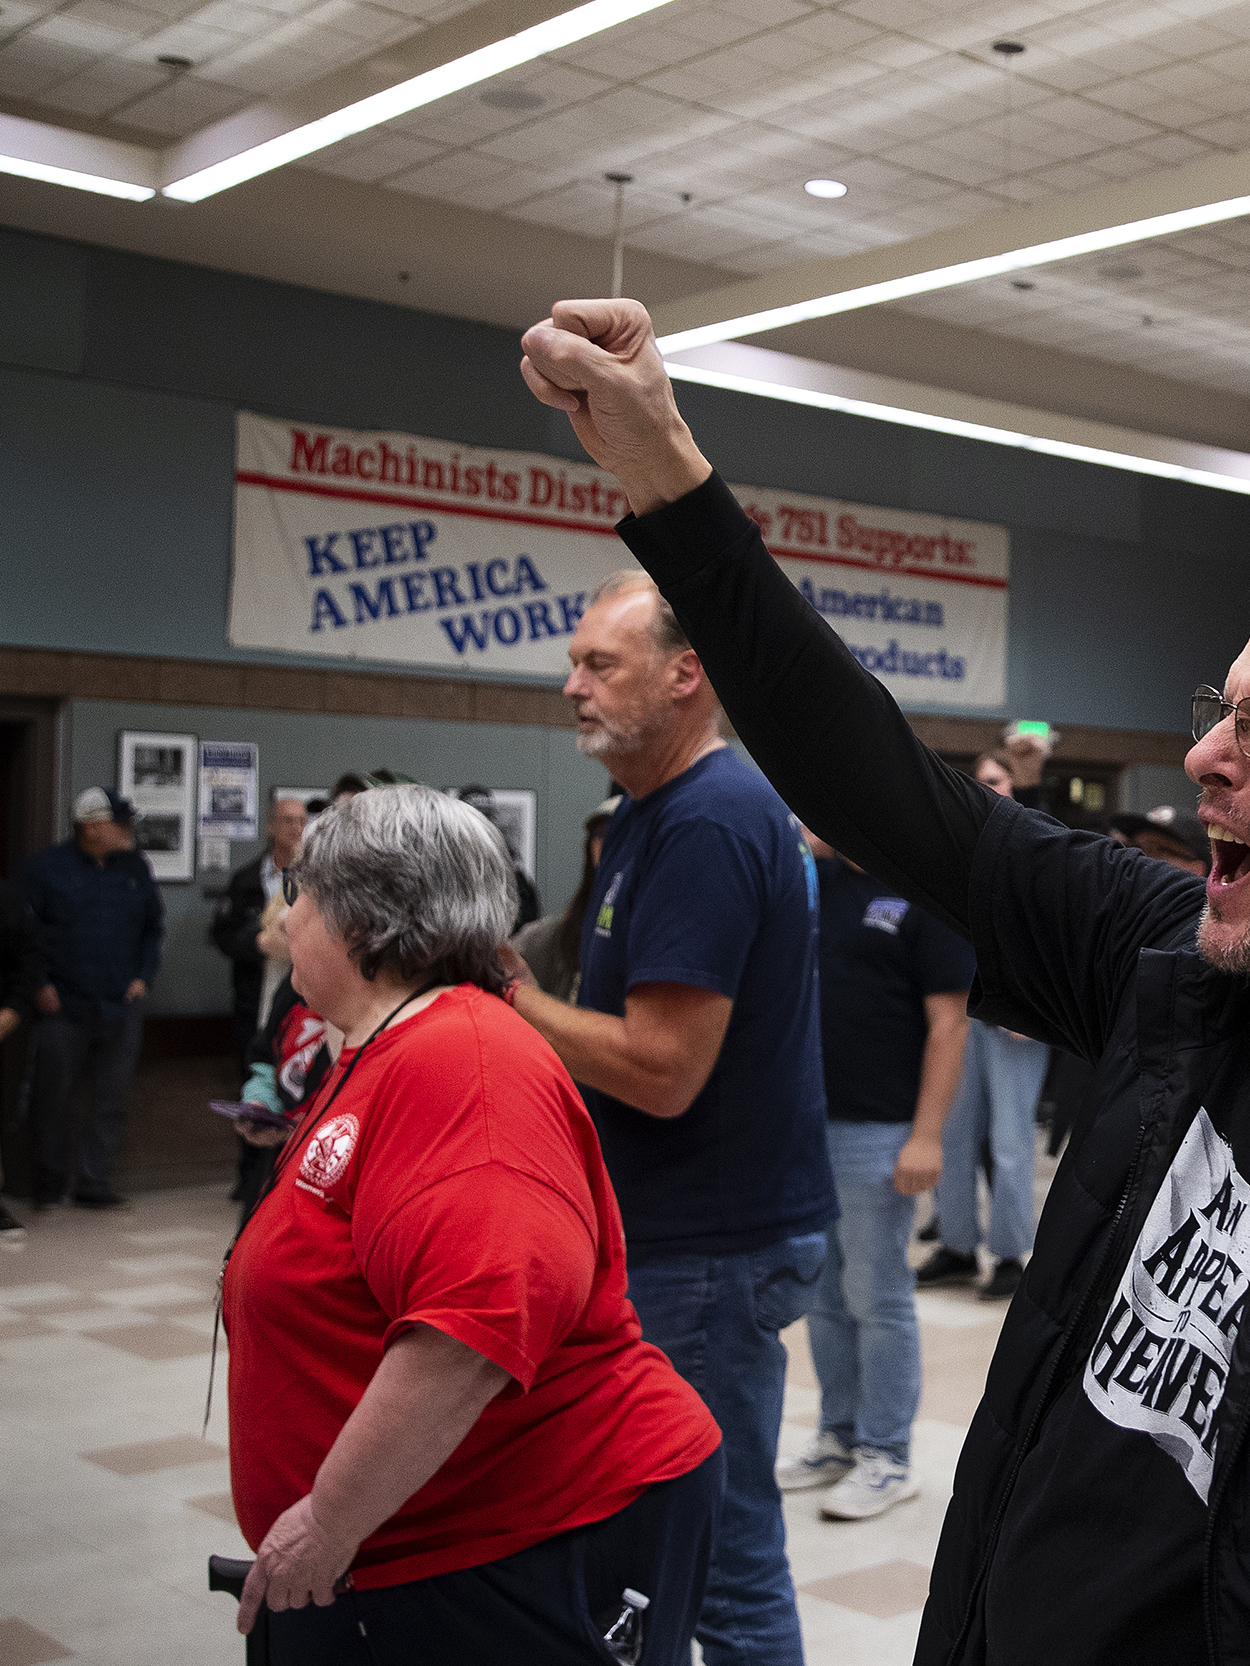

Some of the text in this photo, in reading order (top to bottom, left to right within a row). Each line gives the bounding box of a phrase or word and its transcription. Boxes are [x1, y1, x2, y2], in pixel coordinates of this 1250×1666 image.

[289, 429, 521, 502] Machinists
[777, 505, 828, 546] 751
[305, 520, 438, 577] KEEP
[309, 554, 547, 632] AMERICA
[801, 577, 944, 627] American
[1197, 1168, 1247, 1236] AN
